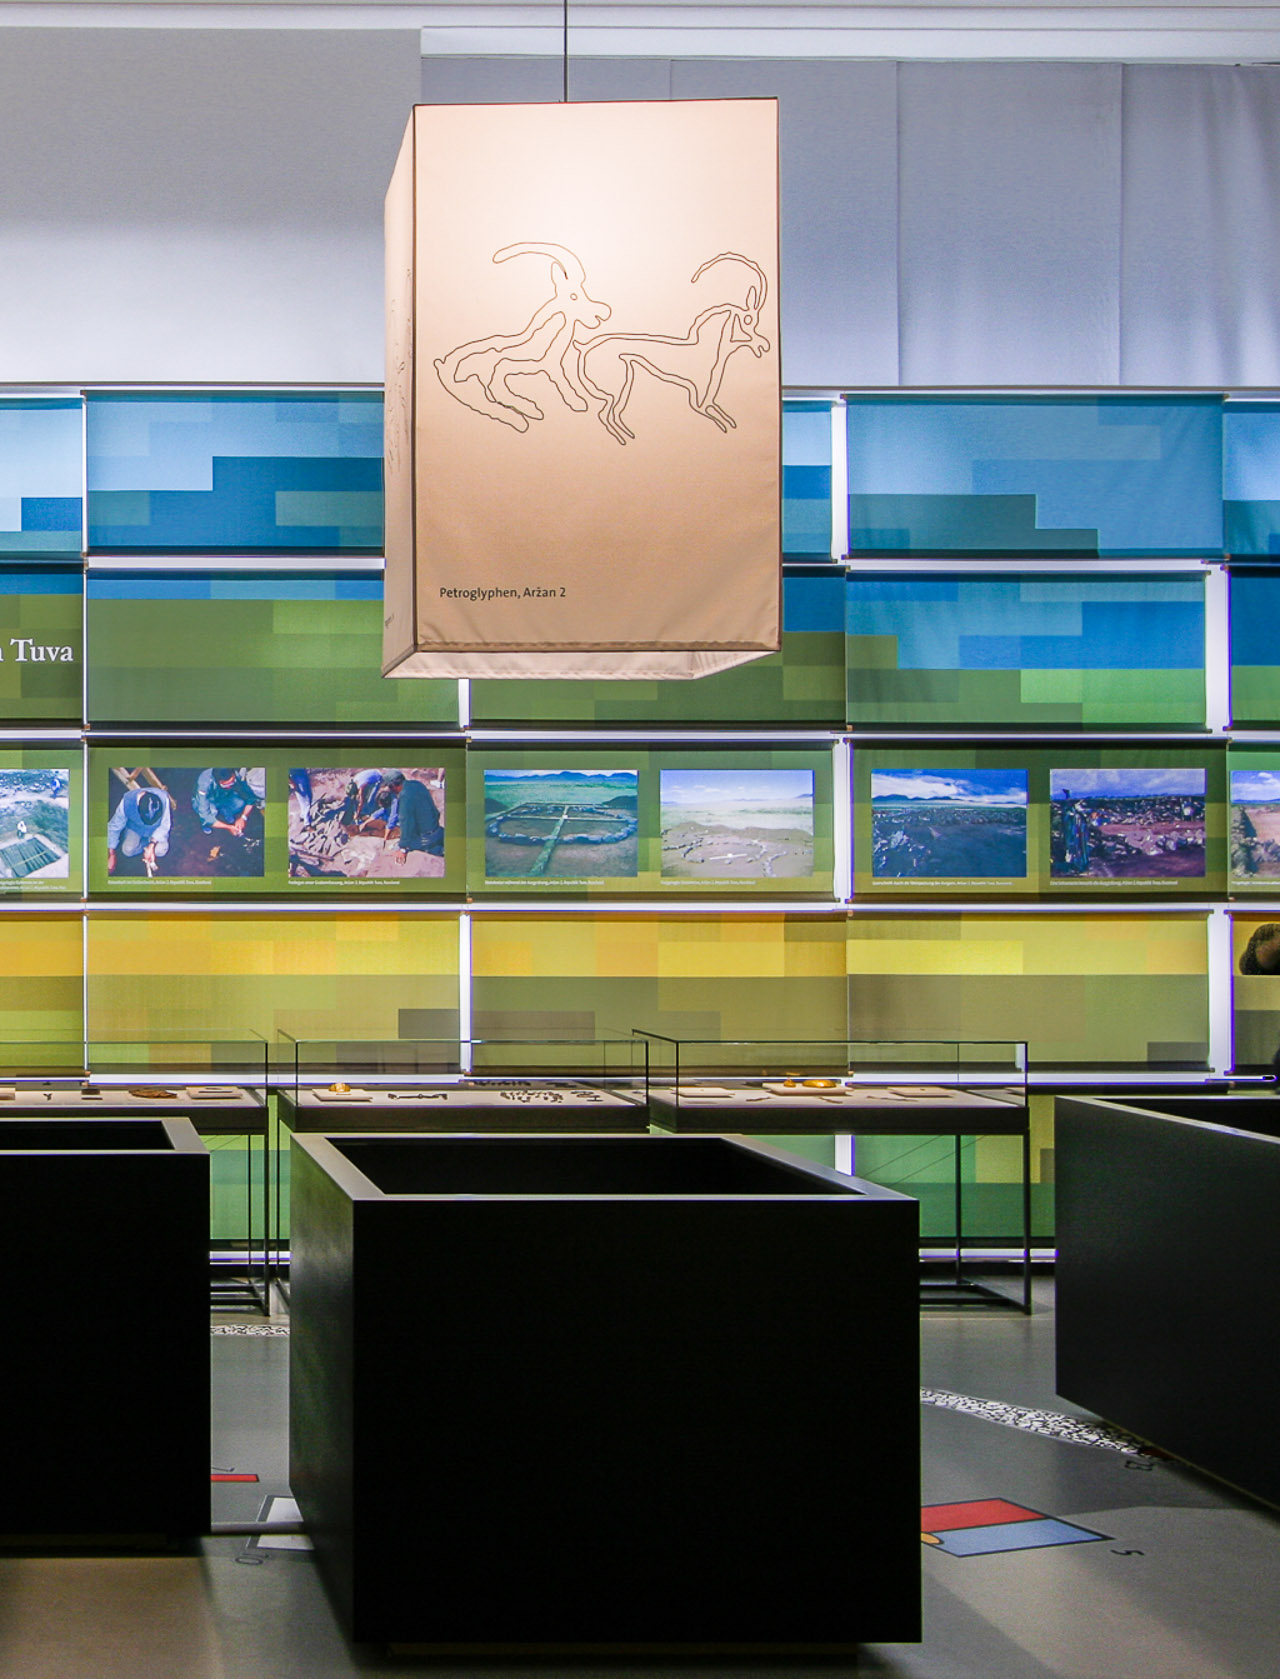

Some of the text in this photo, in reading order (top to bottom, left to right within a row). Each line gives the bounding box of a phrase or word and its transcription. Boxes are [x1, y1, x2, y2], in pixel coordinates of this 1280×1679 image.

[440, 587, 567, 602] Petroglyphen, Aržan 2
[9, 638, 74, 663] Tuva
